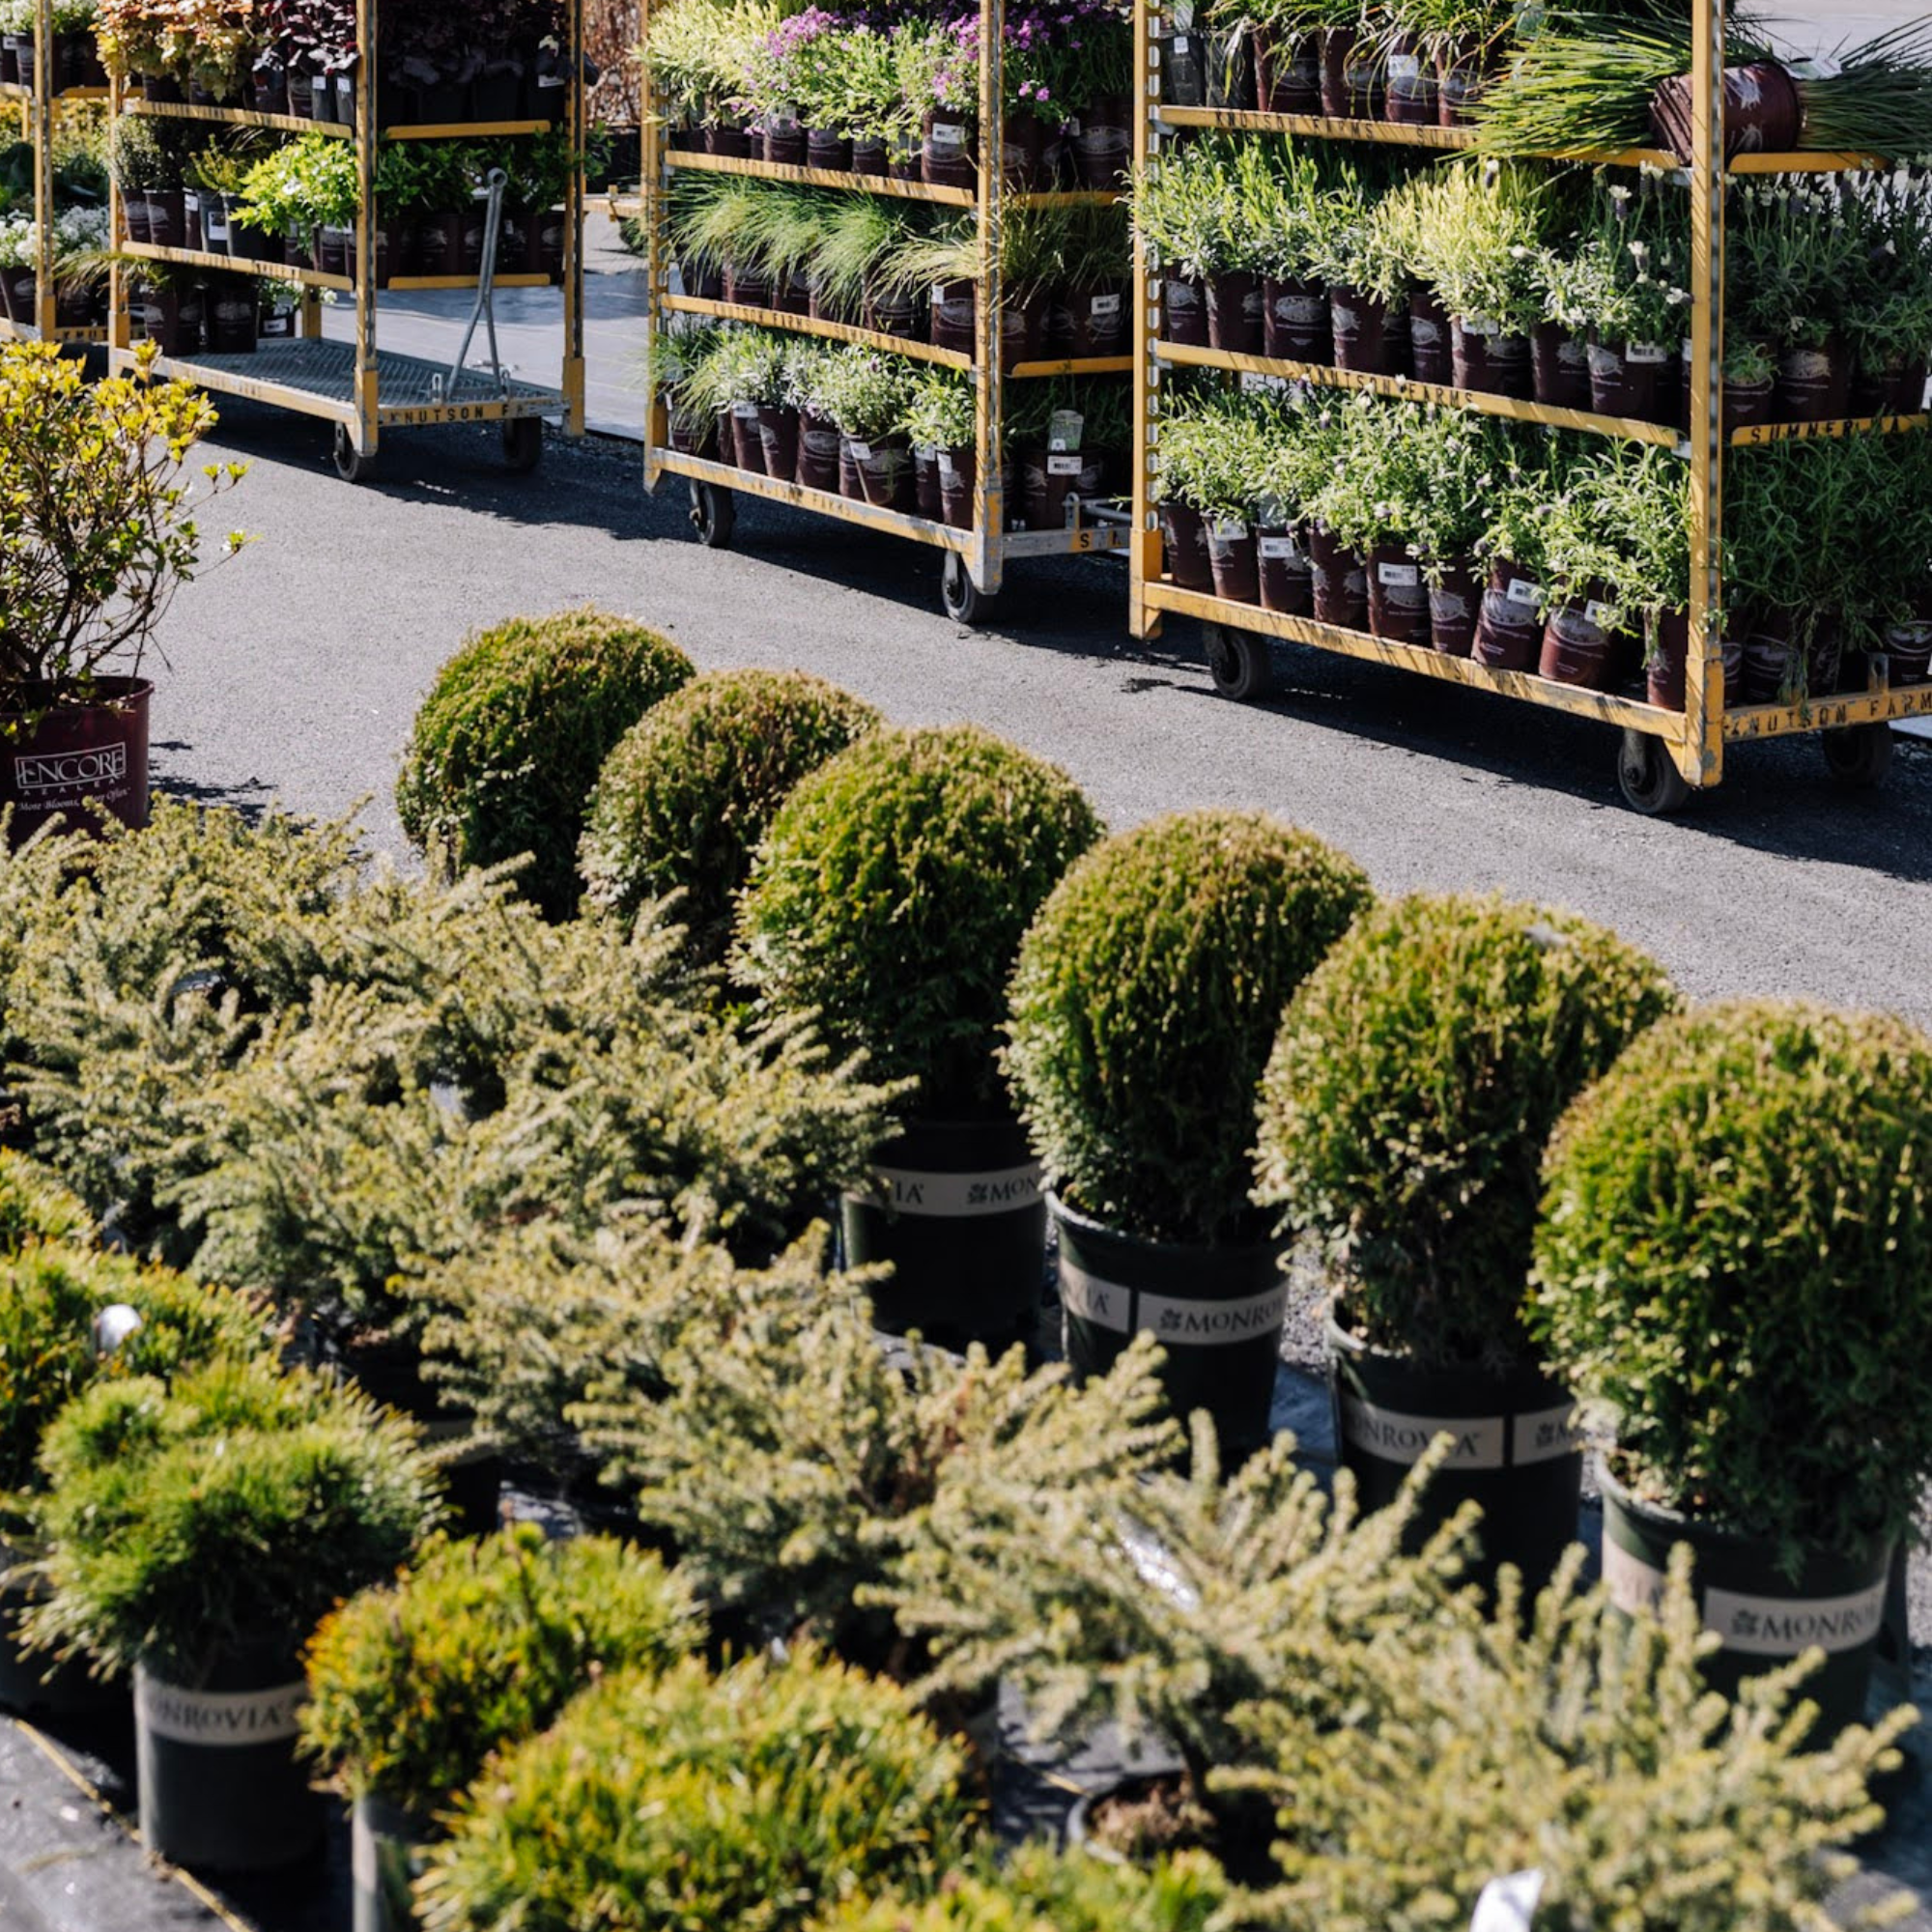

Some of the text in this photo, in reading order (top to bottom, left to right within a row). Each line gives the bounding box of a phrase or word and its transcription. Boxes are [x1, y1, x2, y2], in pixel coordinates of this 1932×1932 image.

[1409, 383, 1473, 408] FARMS
[390, 407, 482, 424] KNUTSON
[20, 750, 123, 784] ENCORE
[23, 778, 116, 796] AZALEA
